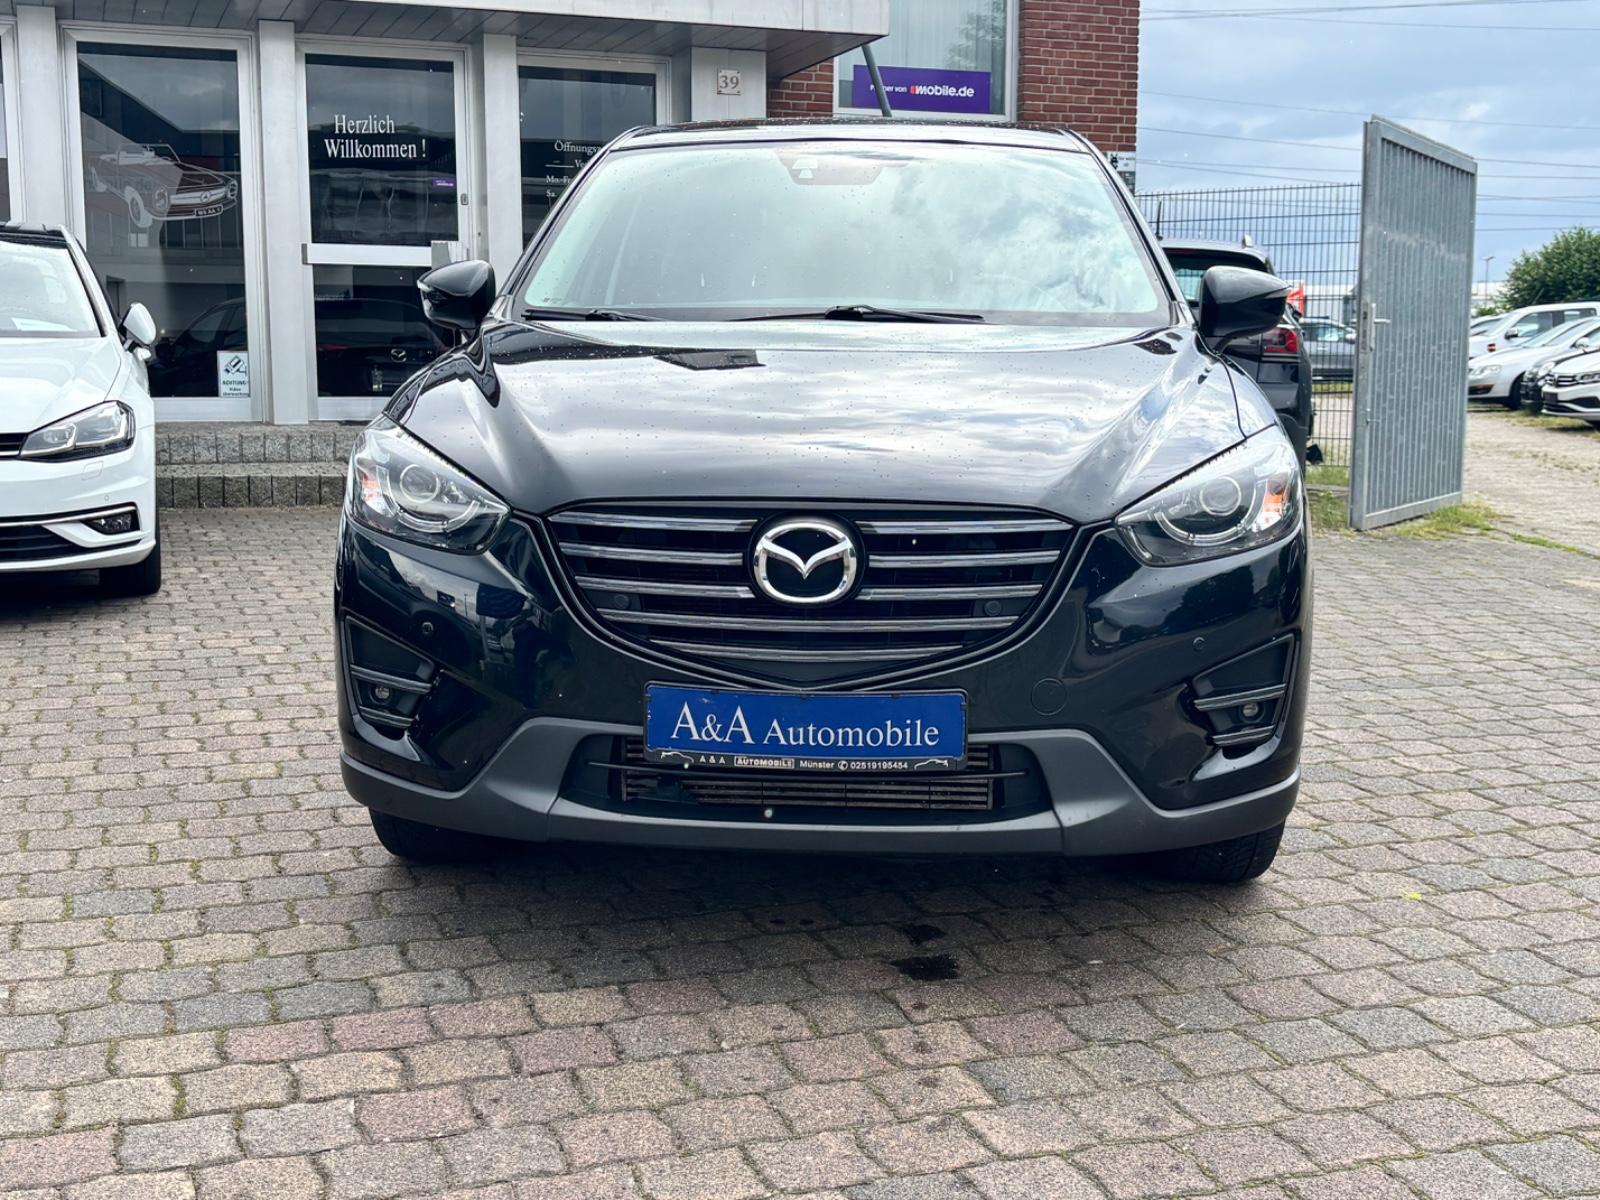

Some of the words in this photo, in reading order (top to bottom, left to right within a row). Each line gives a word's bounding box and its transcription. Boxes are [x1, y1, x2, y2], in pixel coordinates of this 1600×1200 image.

[719, 75, 739, 89] 39
[334, 114, 395, 134] Herzlich
[324, 139, 417, 158] Willkommen
[421, 139, 426, 157] !
[670, 701, 755, 744] A&A
[763, 718, 939, 747] Automobile
[700, 755, 706, 763] A
[709, 755, 715, 763] &
[719, 756, 725, 764] A
[736, 757, 793, 767] AUTOMOBILE
[800, 760, 835, 769] Münster
